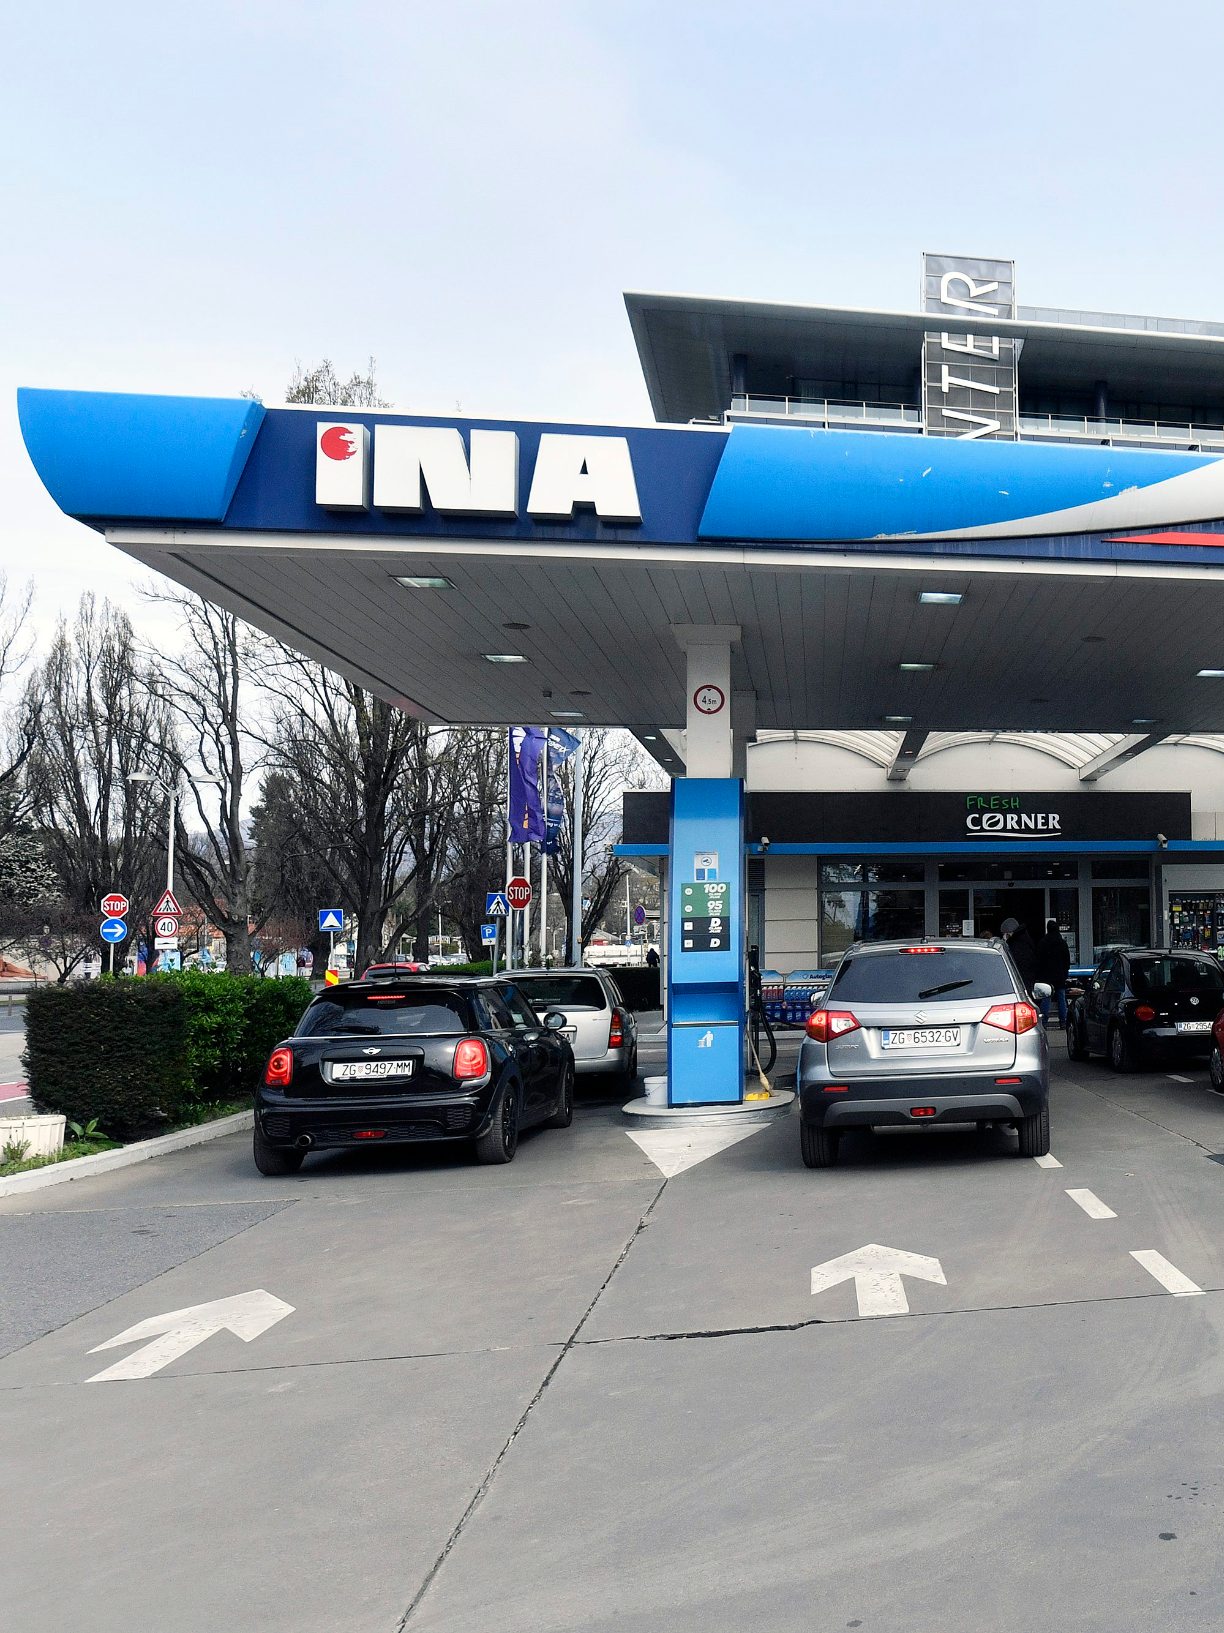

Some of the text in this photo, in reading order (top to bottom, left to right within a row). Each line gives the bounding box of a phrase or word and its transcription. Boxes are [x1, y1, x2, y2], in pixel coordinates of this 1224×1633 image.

[966, 795, 1020, 809] FRESH
[966, 812, 1061, 831] CORNER
[508, 886, 530, 900] STOP
[703, 883, 727, 893] 100
[103, 901, 127, 911] STOP
[707, 900, 724, 910] 95
[160, 921, 173, 933] 40
[710, 917, 722, 928] D
[485, 928, 493, 938] P
[709, 937, 721, 948] D
[891, 1029, 959, 1045] ZG 6532-GV
[342, 1061, 411, 1076] ZG 9497-MM
